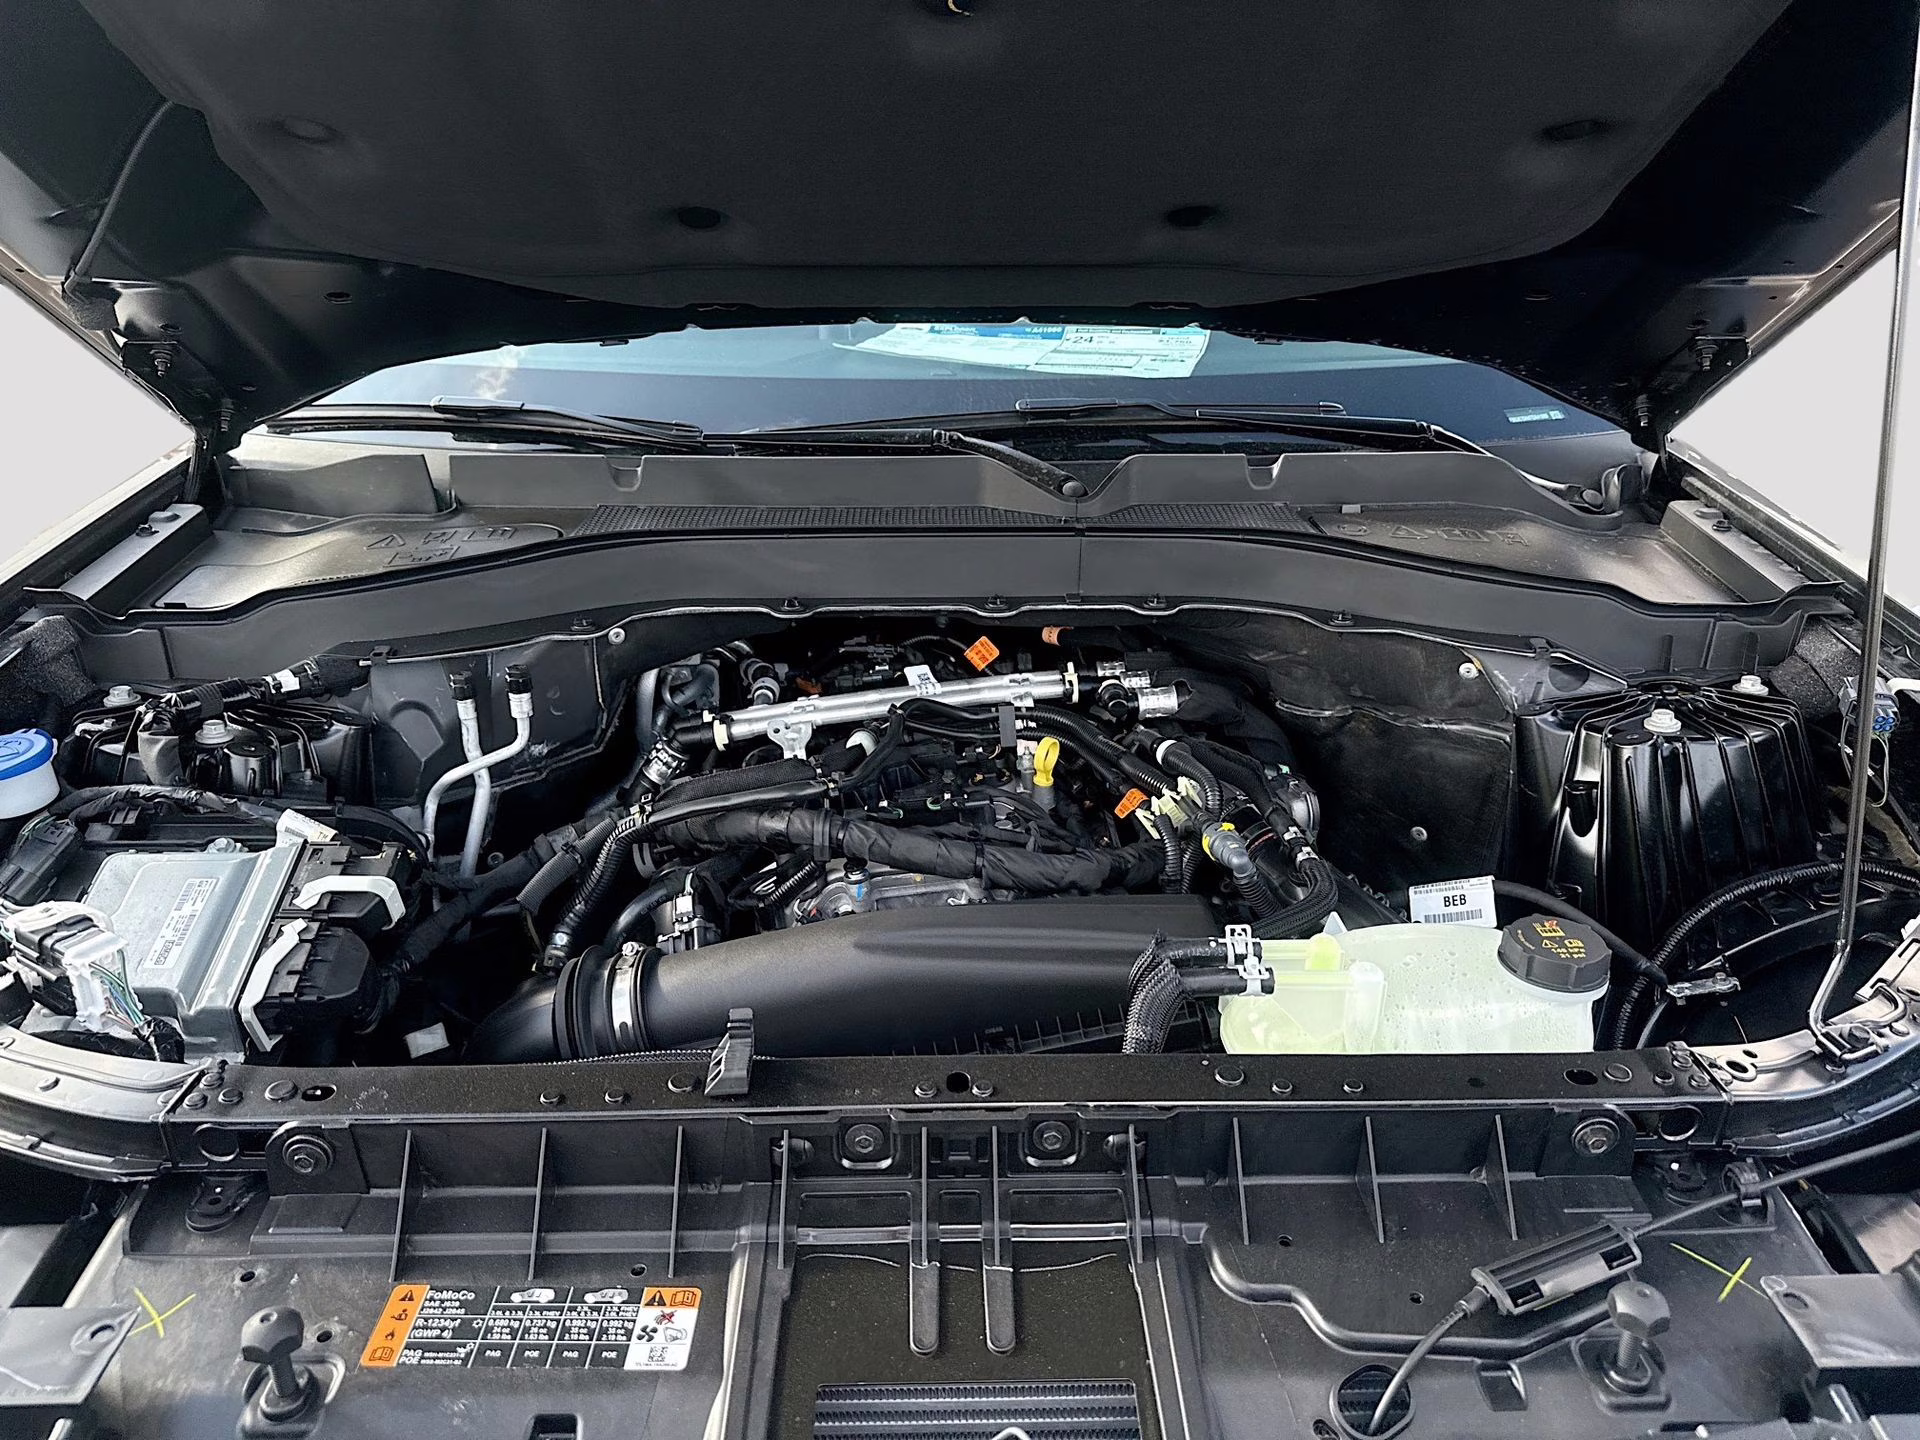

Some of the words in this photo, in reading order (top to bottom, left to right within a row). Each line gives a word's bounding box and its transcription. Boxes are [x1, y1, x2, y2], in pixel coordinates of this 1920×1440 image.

[1444, 894, 1466, 907] BEB
[426, 1290, 475, 1300] FoMoCo
[416, 1319, 461, 1328] R-1234yf
[510, 1319, 520, 1328] kg
[547, 1320, 557, 1328] kg
[587, 1320, 597, 1328] kg
[624, 1320, 634, 1329] kg
[411, 1329, 441, 1338] (GWP
[442, 1329, 452, 1338] 4)
